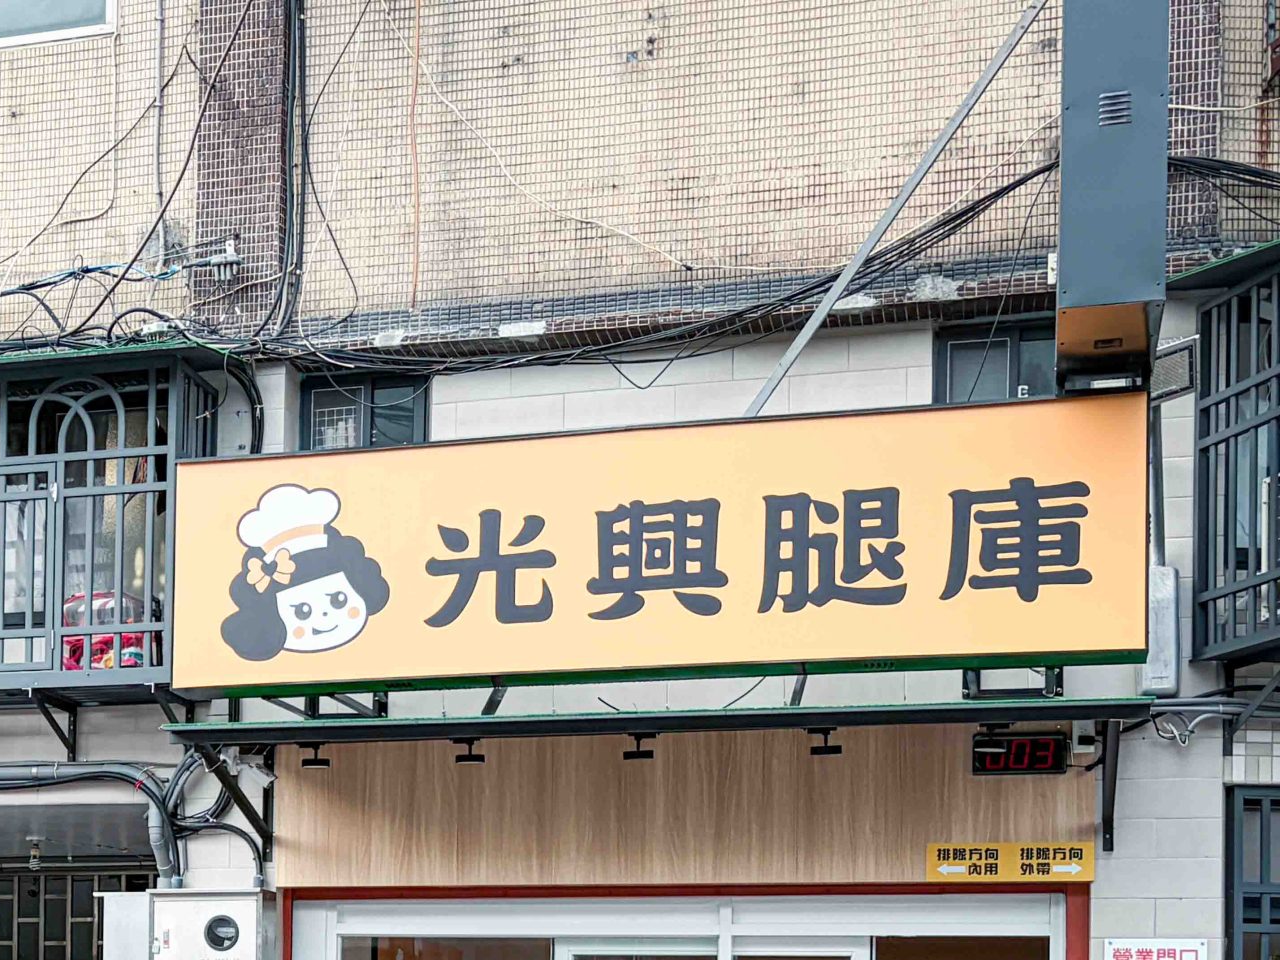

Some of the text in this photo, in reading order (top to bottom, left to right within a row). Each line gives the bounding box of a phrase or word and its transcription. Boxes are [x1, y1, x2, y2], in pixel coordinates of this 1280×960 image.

[424, 476, 1093, 628] 光興腿庫
[936, 847, 999, 861] 排隊方向
[1019, 847, 1084, 861] 排隊方向
[1019, 863, 1051, 876] 外帶
